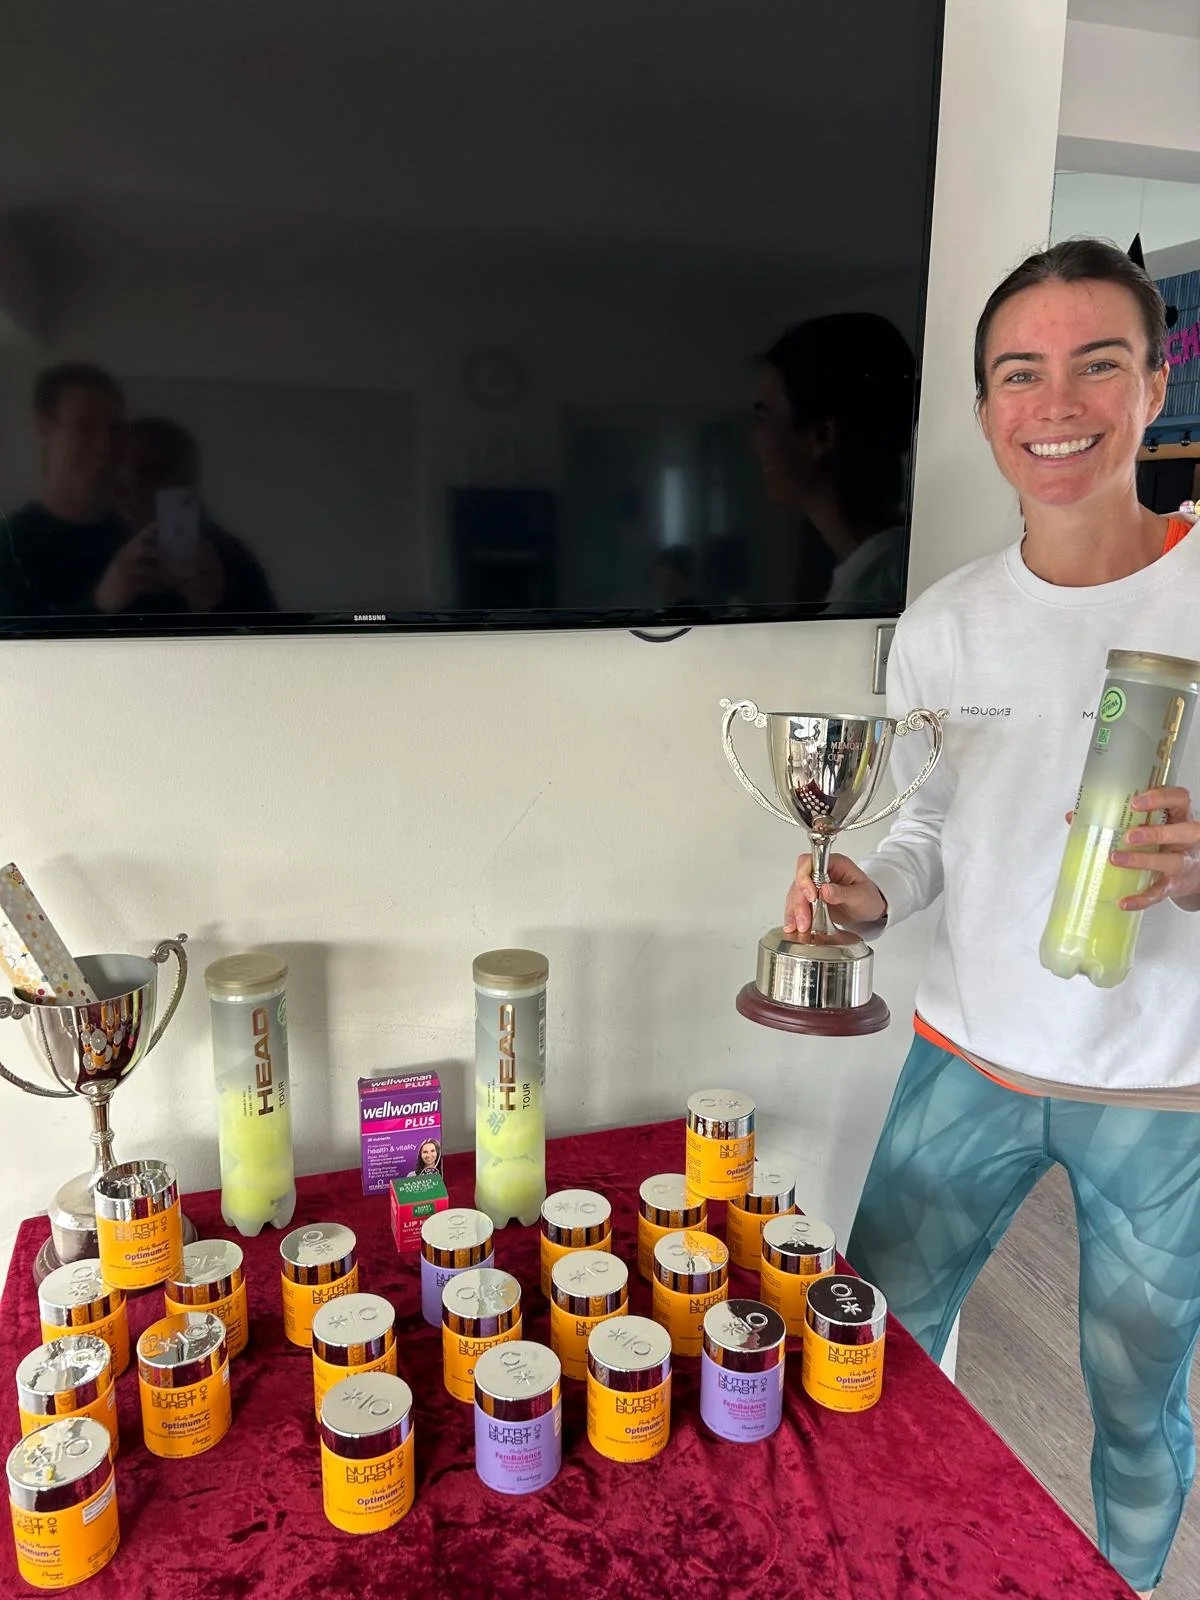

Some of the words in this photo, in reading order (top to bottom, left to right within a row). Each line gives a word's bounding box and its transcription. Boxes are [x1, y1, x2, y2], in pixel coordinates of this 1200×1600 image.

[252, 1006, 274, 1116] HEAD
[499, 1004, 516, 1111] HEAD
[371, 1074, 432, 1087] wellwoman
[404, 1080, 432, 1089] PLUS
[278, 1081, 286, 1109] TOUR
[522, 1082, 531, 1110] TOUR
[363, 1100, 439, 1120] wellwoman
[404, 1116, 435, 1128] PLUS
[396, 1143, 417, 1152] vitality
[404, 1220, 418, 1228] LIP
[125, 1243, 170, 1261] Optimum-C
[828, 1345, 871, 1358] NUTRI
[828, 1353, 869, 1365] BURST
[718, 1372, 758, 1387] NUTRI
[836, 1371, 878, 1384] Optimum-C
[718, 1380, 758, 1395] BURST
[151, 1388, 197, 1403] NUTRI
[616, 1393, 659, 1407] NUTRI
[152, 1397, 195, 1409] BURST
[616, 1401, 657, 1414] BURST
[724, 1399, 766, 1410] FemBalance
[161, 1413, 210, 1430] Optimum-C
[488, 1423, 532, 1437] NUTRI
[488, 1431, 531, 1445] BURST
[495, 1451, 541, 1461] FemBalance
[346, 1457, 395, 1475] NUTRI
[346, 1465, 393, 1484] BURST
[357, 1480, 405, 1505] Optimum-C
